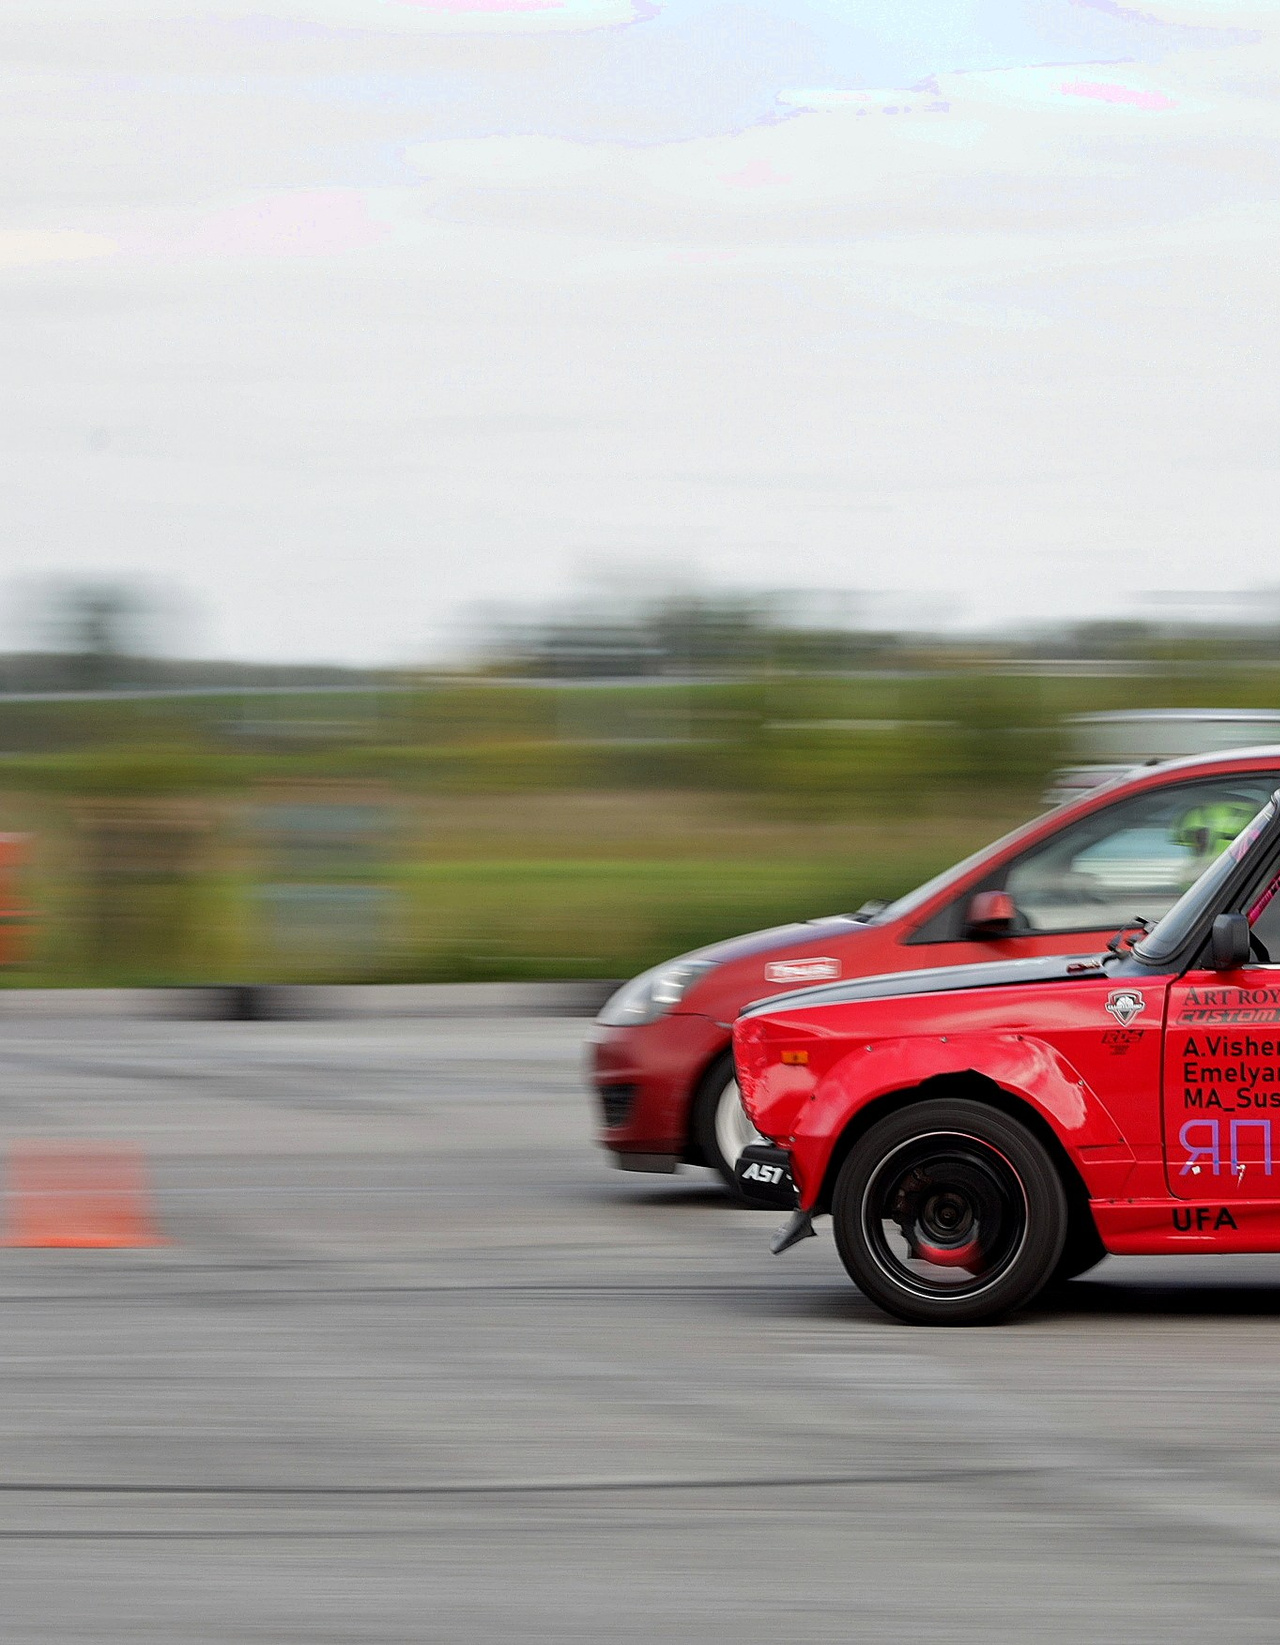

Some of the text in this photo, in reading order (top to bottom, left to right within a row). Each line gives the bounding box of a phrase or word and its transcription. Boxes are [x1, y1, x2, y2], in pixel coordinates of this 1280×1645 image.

[1184, 986, 1233, 1006] ART
[741, 1162, 784, 1185] A51
[1172, 1207, 1238, 1231] UFA
